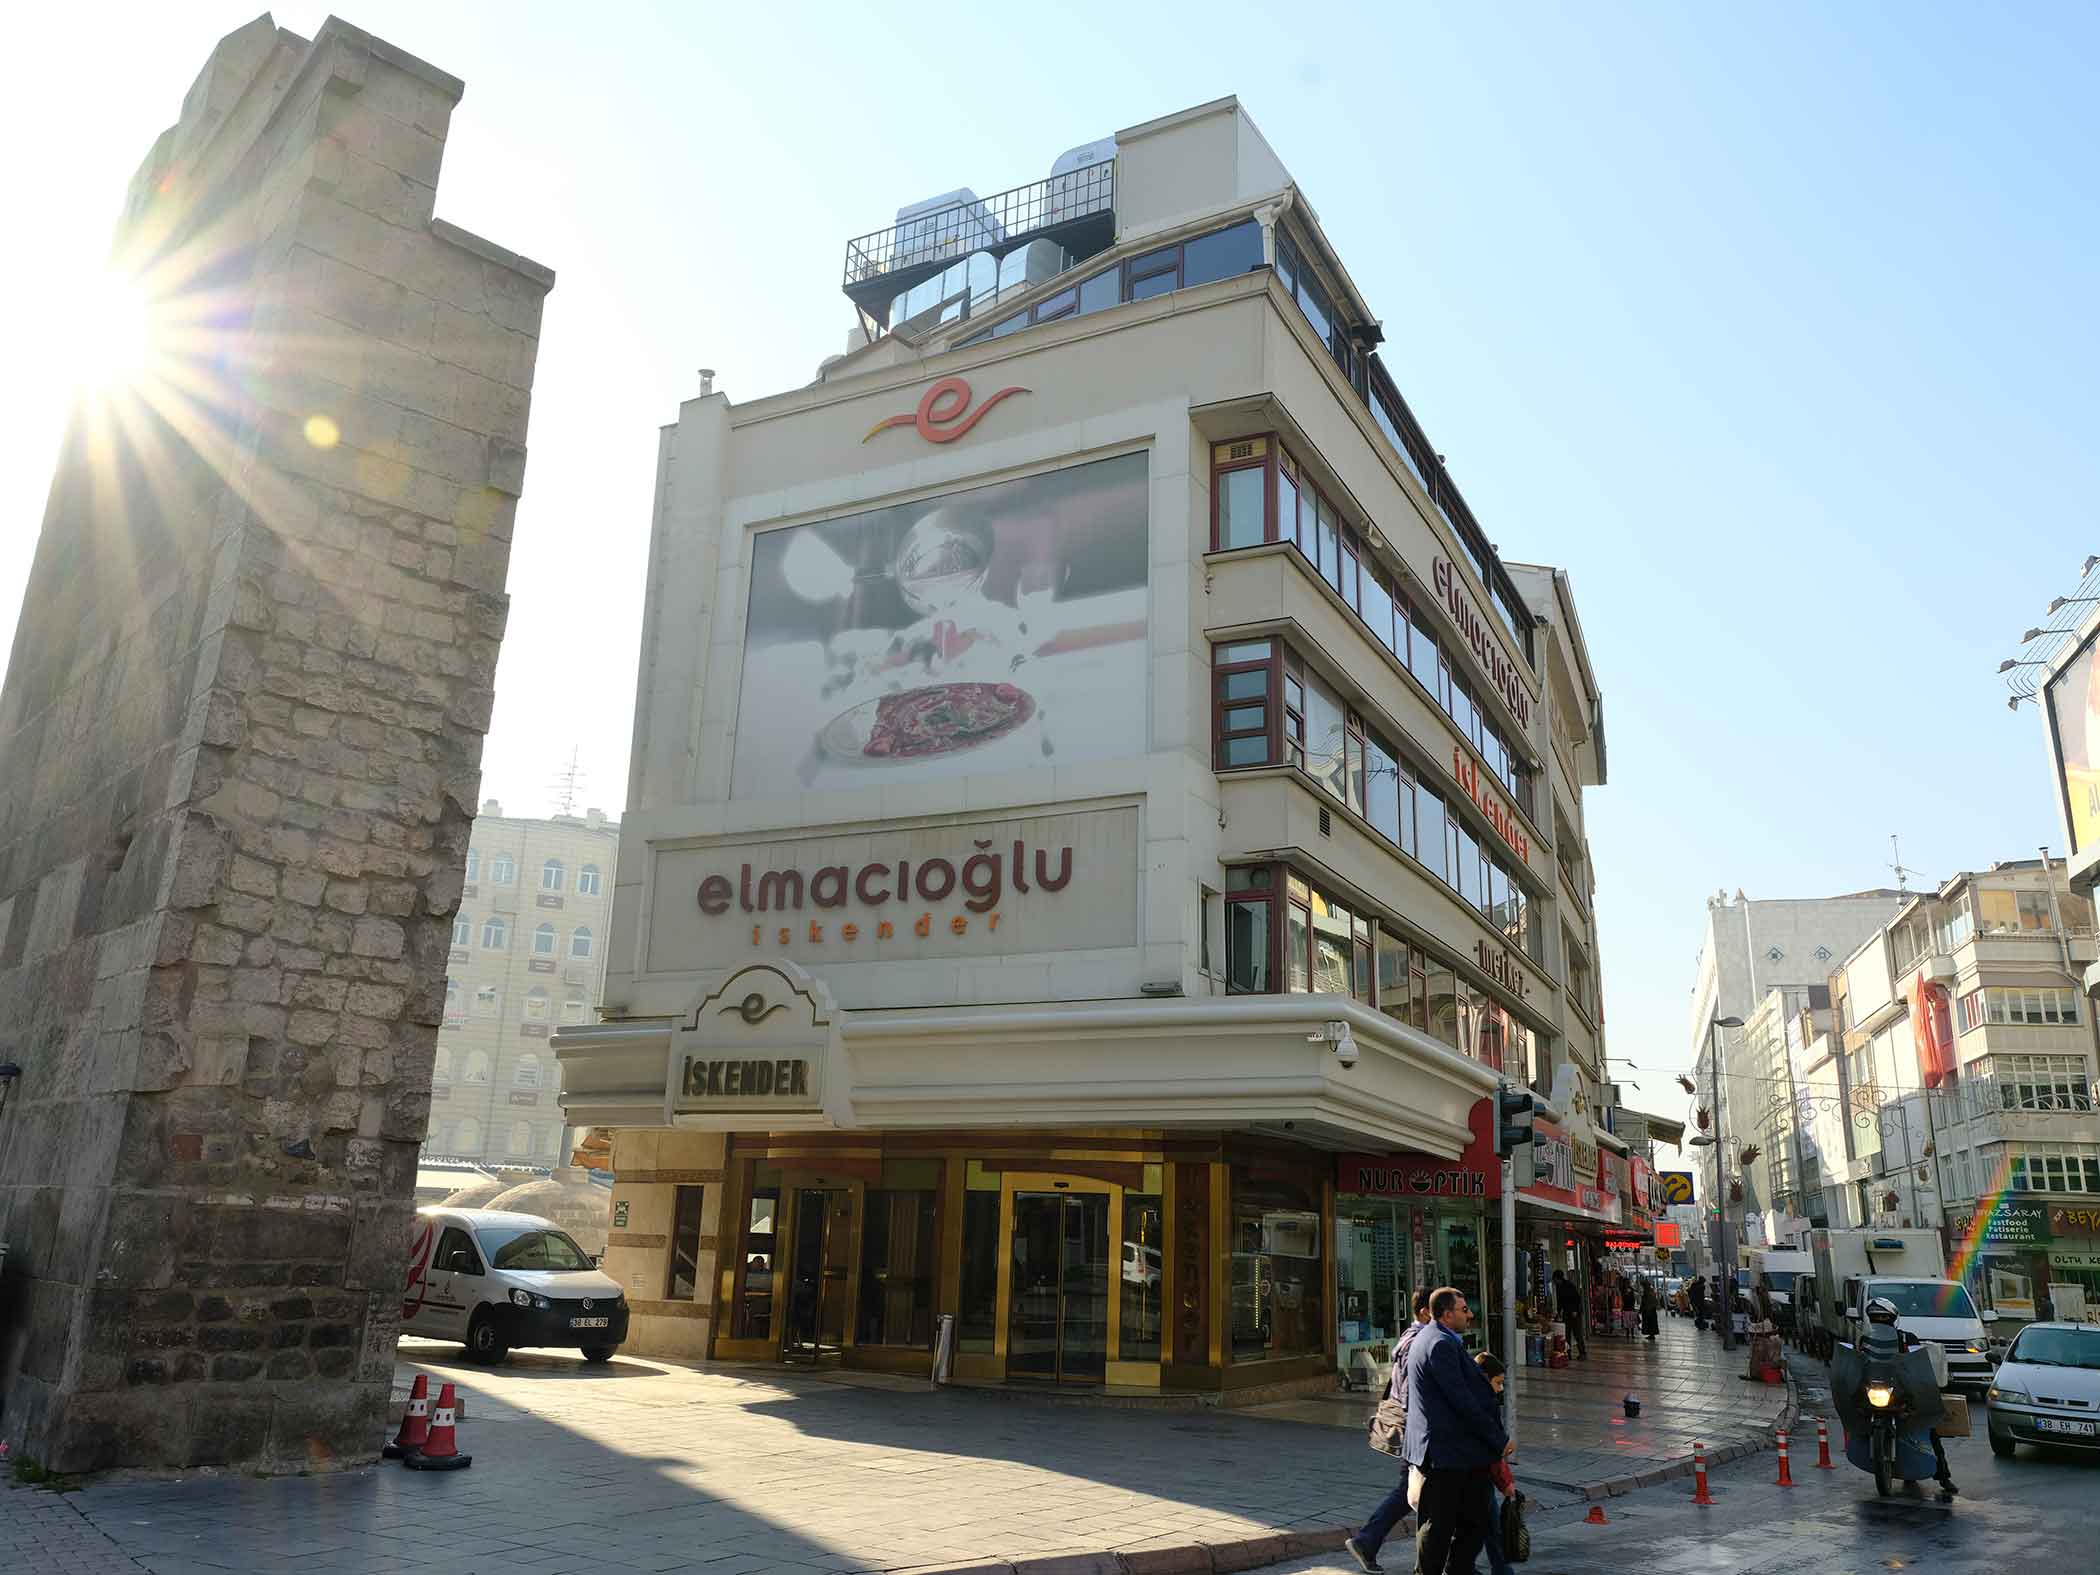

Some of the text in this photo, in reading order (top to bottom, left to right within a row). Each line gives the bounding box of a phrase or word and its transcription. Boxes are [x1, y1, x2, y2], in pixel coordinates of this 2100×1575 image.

[697, 839, 1073, 916] elmacıoğlu
[751, 912, 1002, 947] iskender
[682, 1055, 809, 1097] İSKENDER
[1359, 1168, 1404, 1193] NUR
[2043, 1420, 2095, 1434] 38 EH 741
